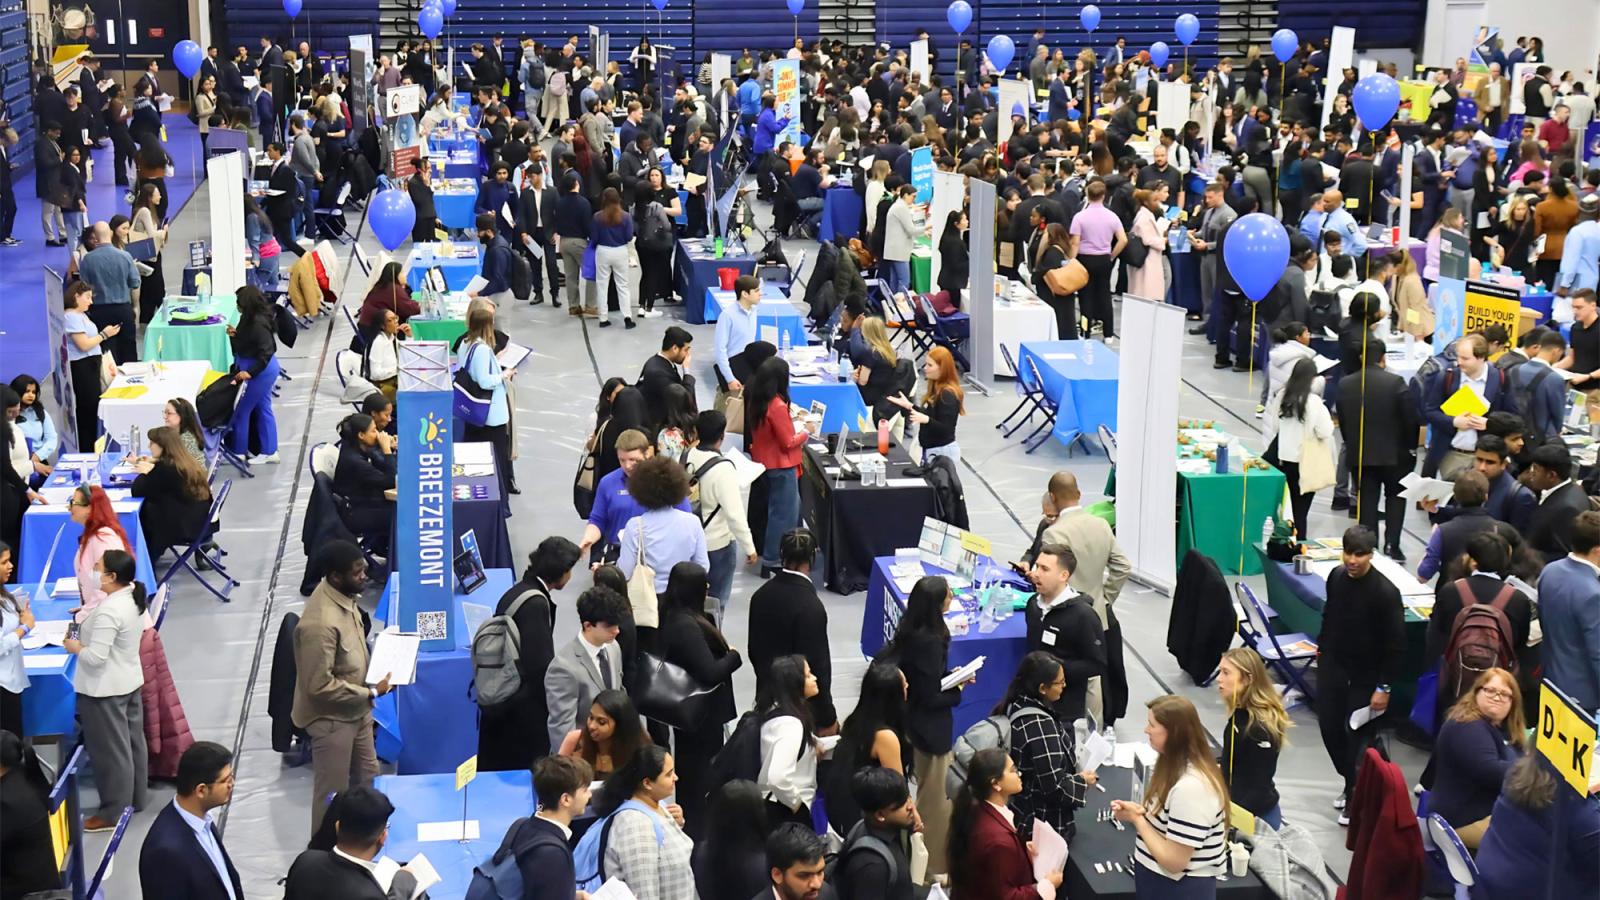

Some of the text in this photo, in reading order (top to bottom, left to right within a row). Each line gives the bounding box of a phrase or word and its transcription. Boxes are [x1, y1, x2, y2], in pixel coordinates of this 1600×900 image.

[1468, 305, 1515, 322] BUILD YOUR
[1466, 316, 1514, 338] DREM
[419, 453, 444, 588] BREEZEMONT
